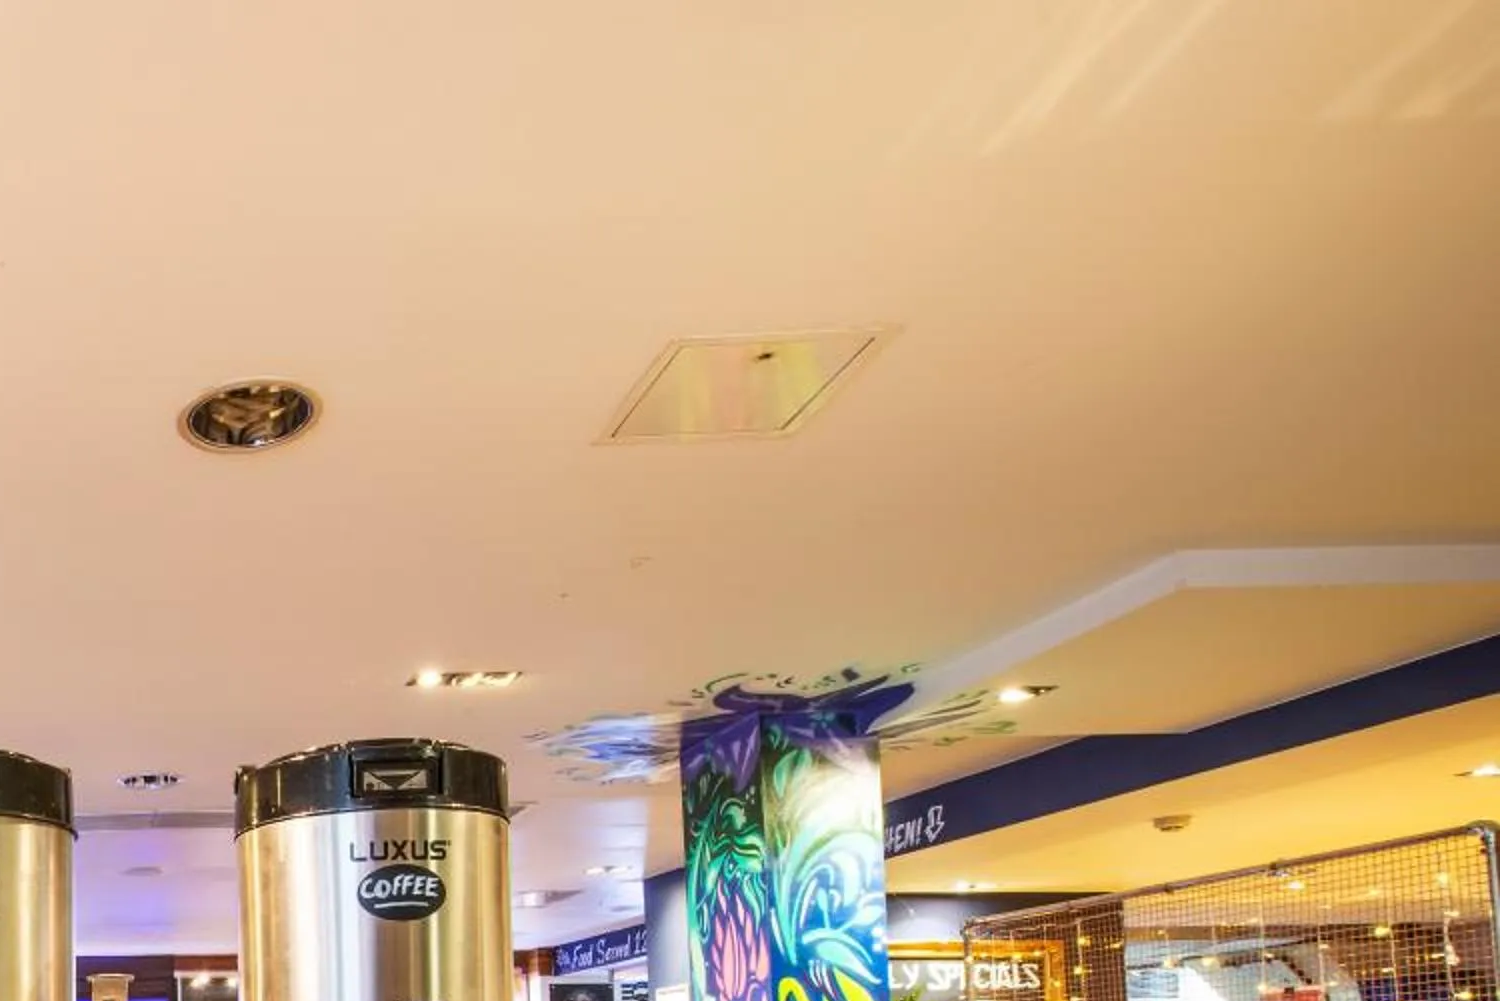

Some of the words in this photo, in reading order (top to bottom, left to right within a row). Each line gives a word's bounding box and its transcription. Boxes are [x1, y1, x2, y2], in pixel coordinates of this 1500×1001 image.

[349, 839, 447, 862] LUXUS
[360, 874, 440, 899] COFFEE
[887, 962, 920, 990] LY
